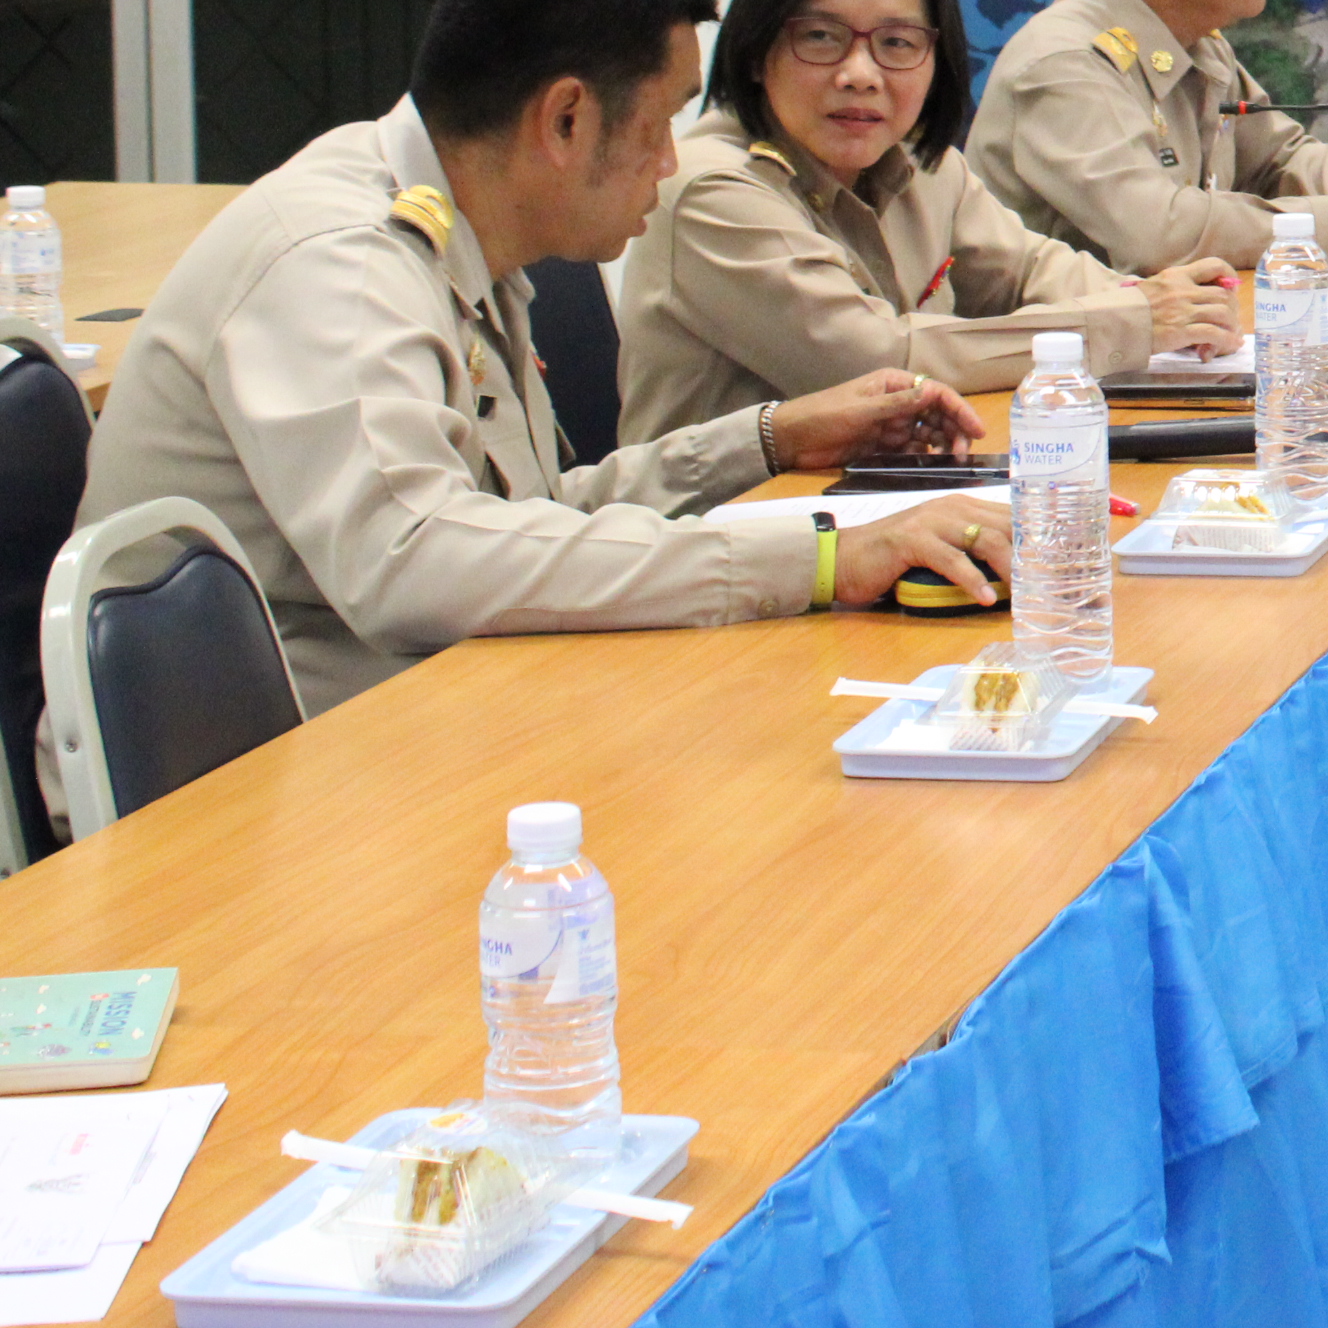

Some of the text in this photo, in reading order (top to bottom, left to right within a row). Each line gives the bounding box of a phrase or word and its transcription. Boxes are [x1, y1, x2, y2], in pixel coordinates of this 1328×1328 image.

[1023, 441, 1075, 454] SINGHA
[1024, 453, 1064, 466] WATER
[98, 991, 138, 1036] MISSION
